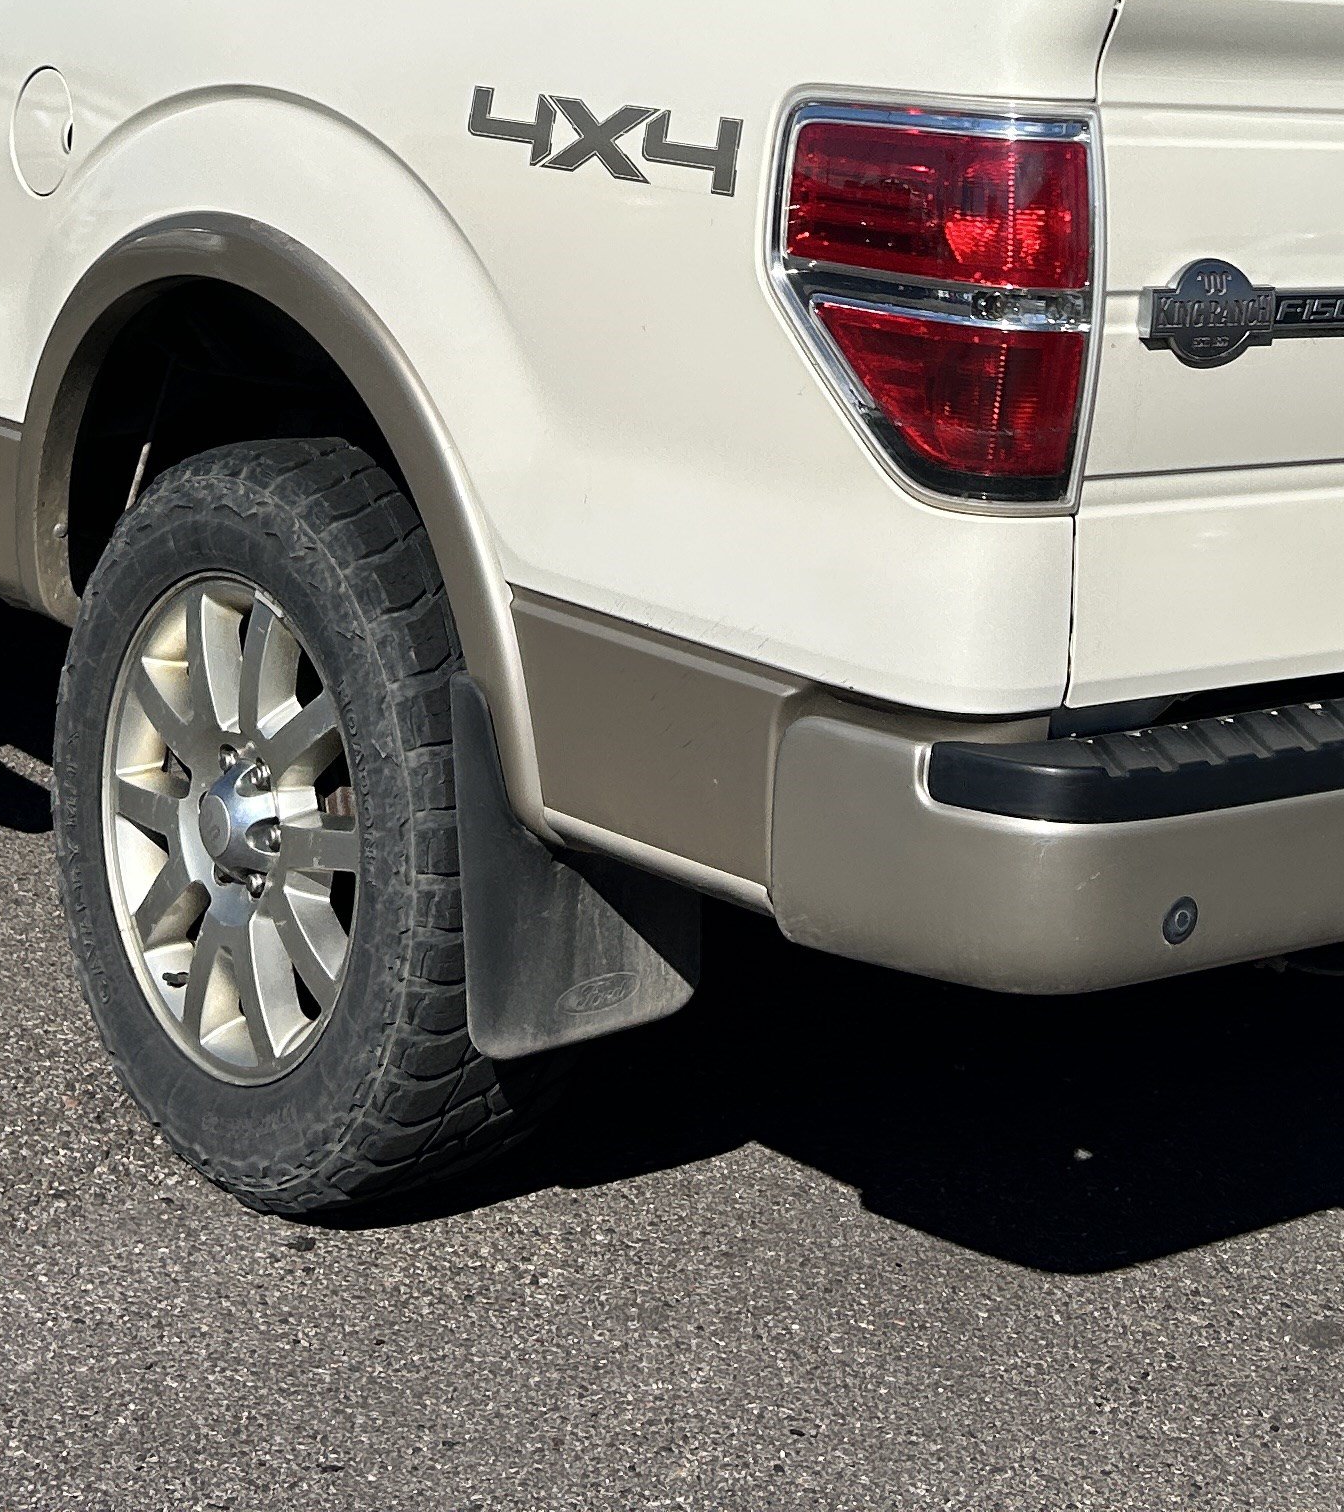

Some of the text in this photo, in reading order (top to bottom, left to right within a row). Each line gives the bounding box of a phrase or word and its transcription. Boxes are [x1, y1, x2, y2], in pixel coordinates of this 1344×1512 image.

[1158, 293, 1272, 328] KING RANCH
[575, 979, 628, 1012] Ford
